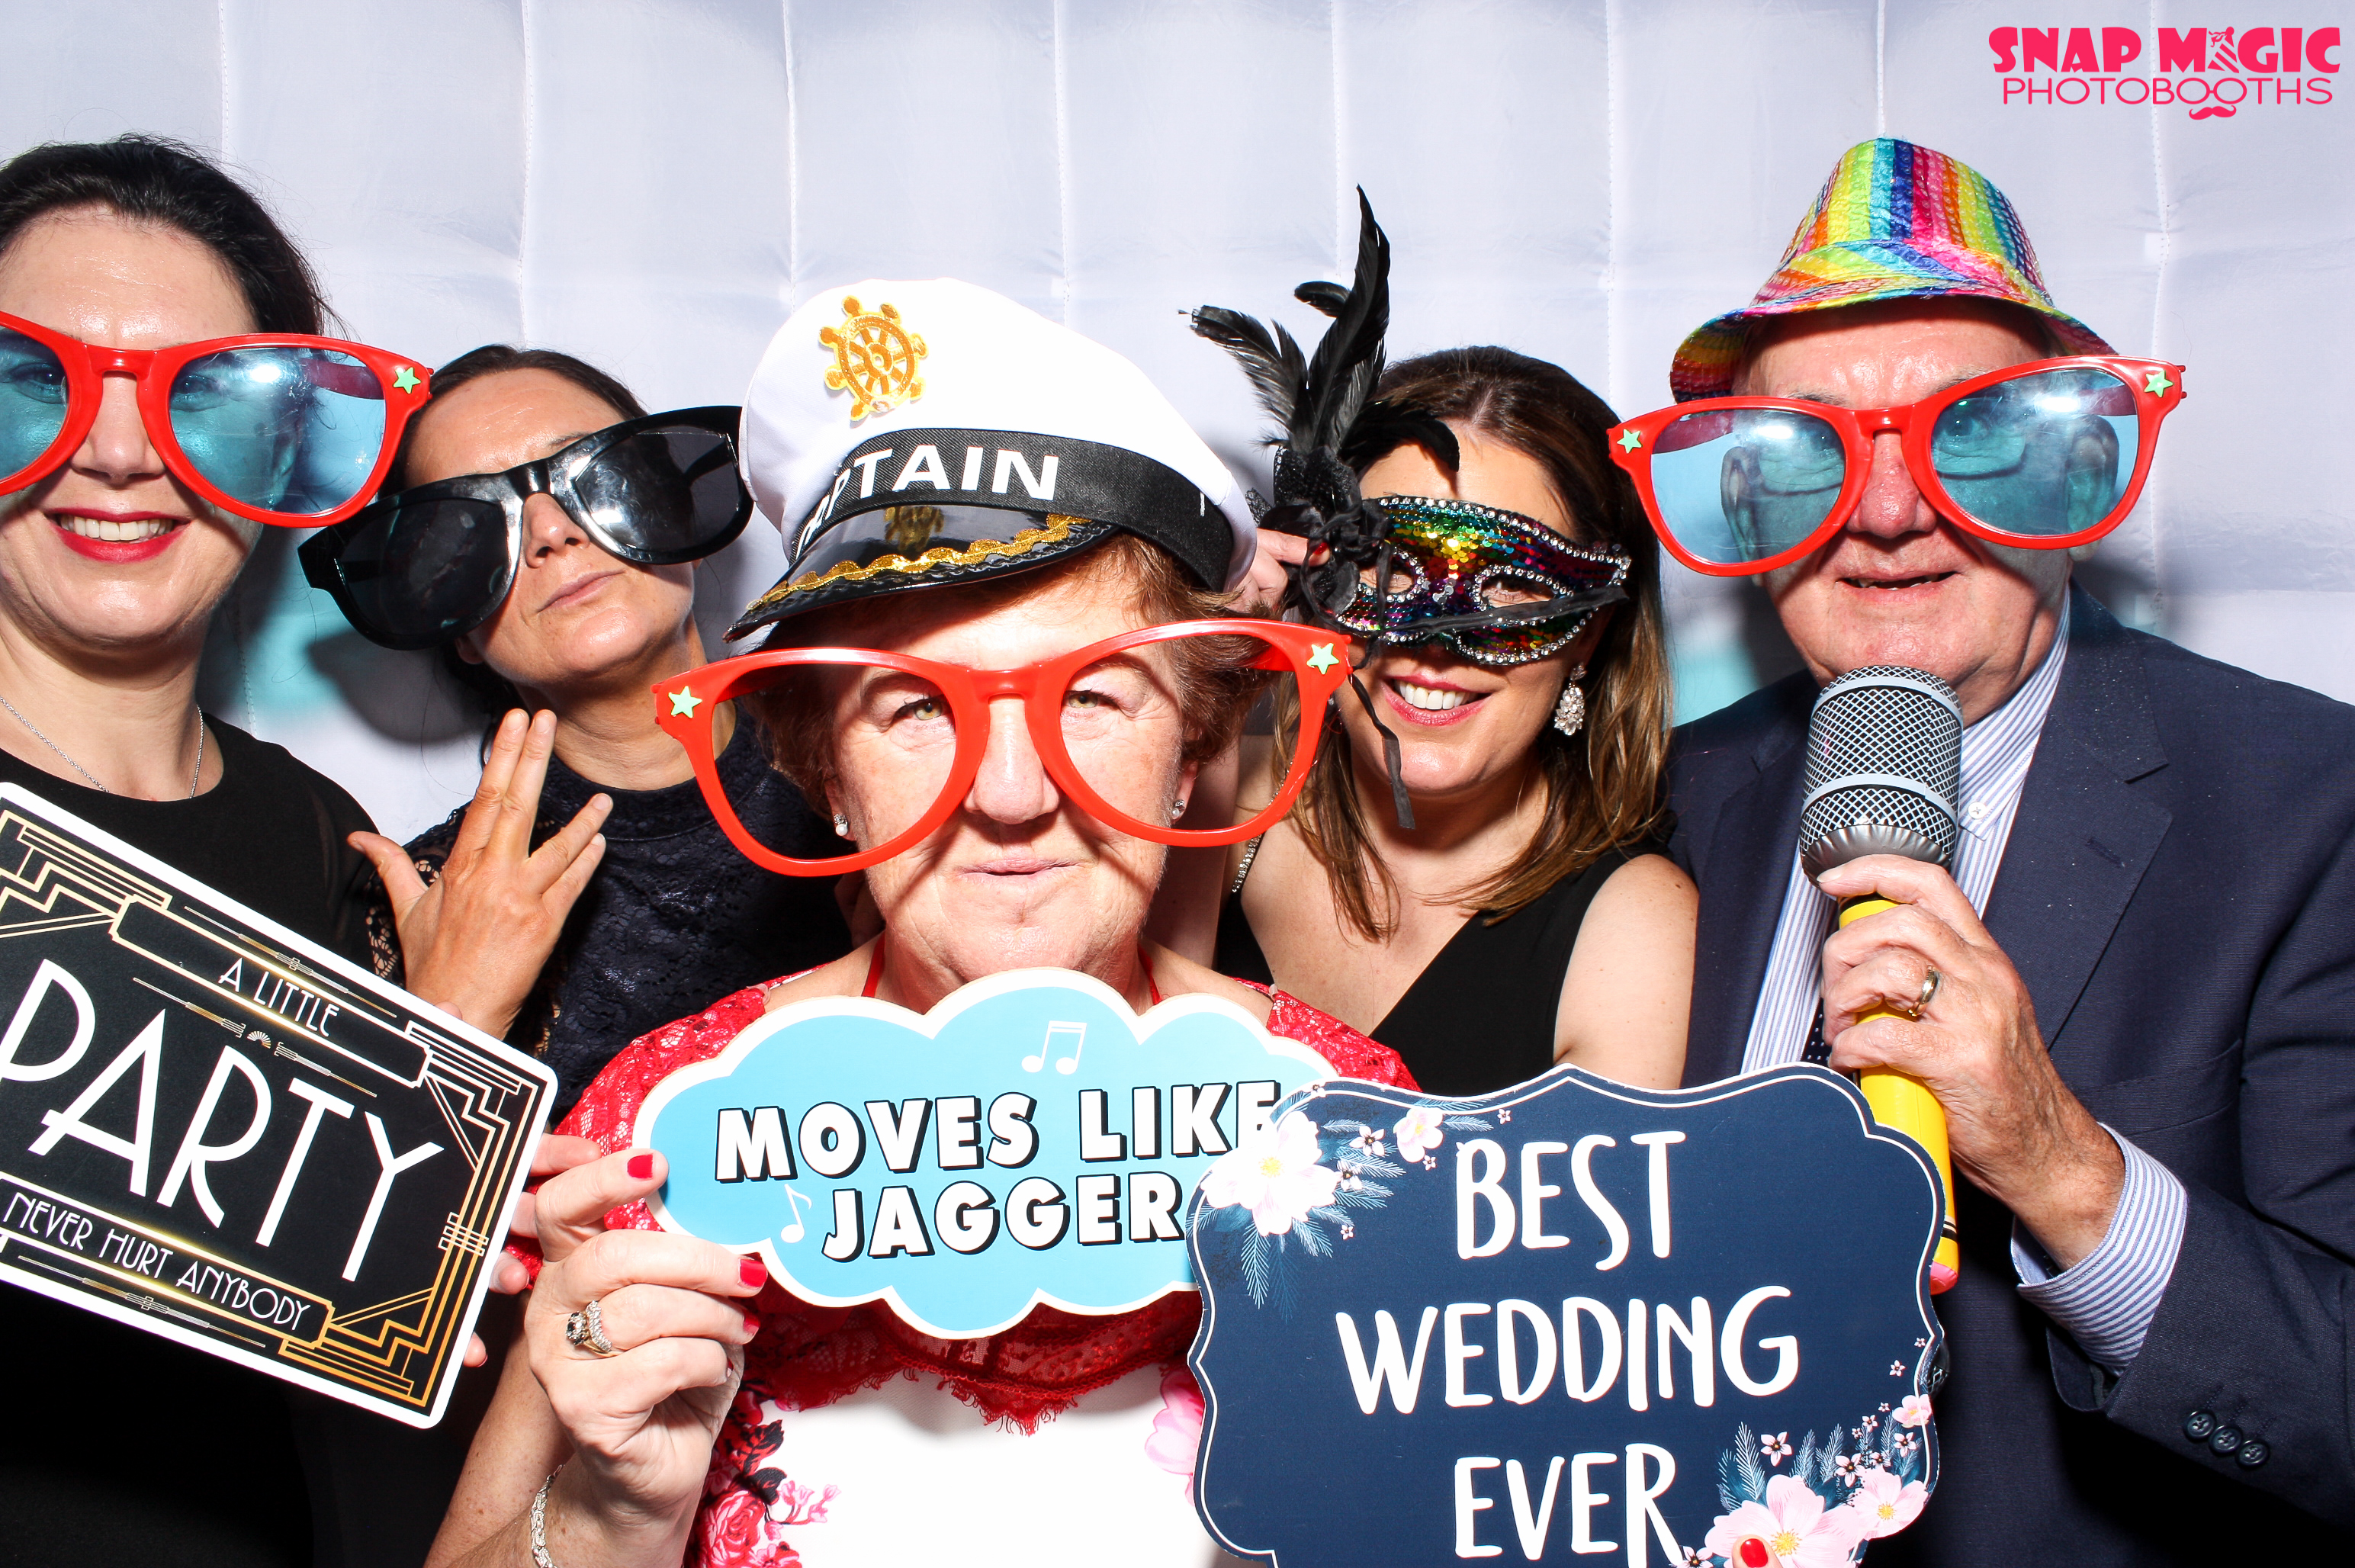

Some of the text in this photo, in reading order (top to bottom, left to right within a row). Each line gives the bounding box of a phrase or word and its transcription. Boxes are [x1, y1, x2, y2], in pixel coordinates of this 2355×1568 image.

[218, 957, 340, 1037] A LITTLE
[0, 958, 445, 1283] PARTY
[715, 1092, 1039, 1184] MOVES
[2, 1191, 311, 1331] NEVER HURT ANYBODY
[821, 1171, 1185, 1262] JAGGER
[1455, 1131, 1686, 1271] BEST
[1335, 1285, 1800, 1415] WEDDING
[1454, 1443, 1684, 1568] EVER
